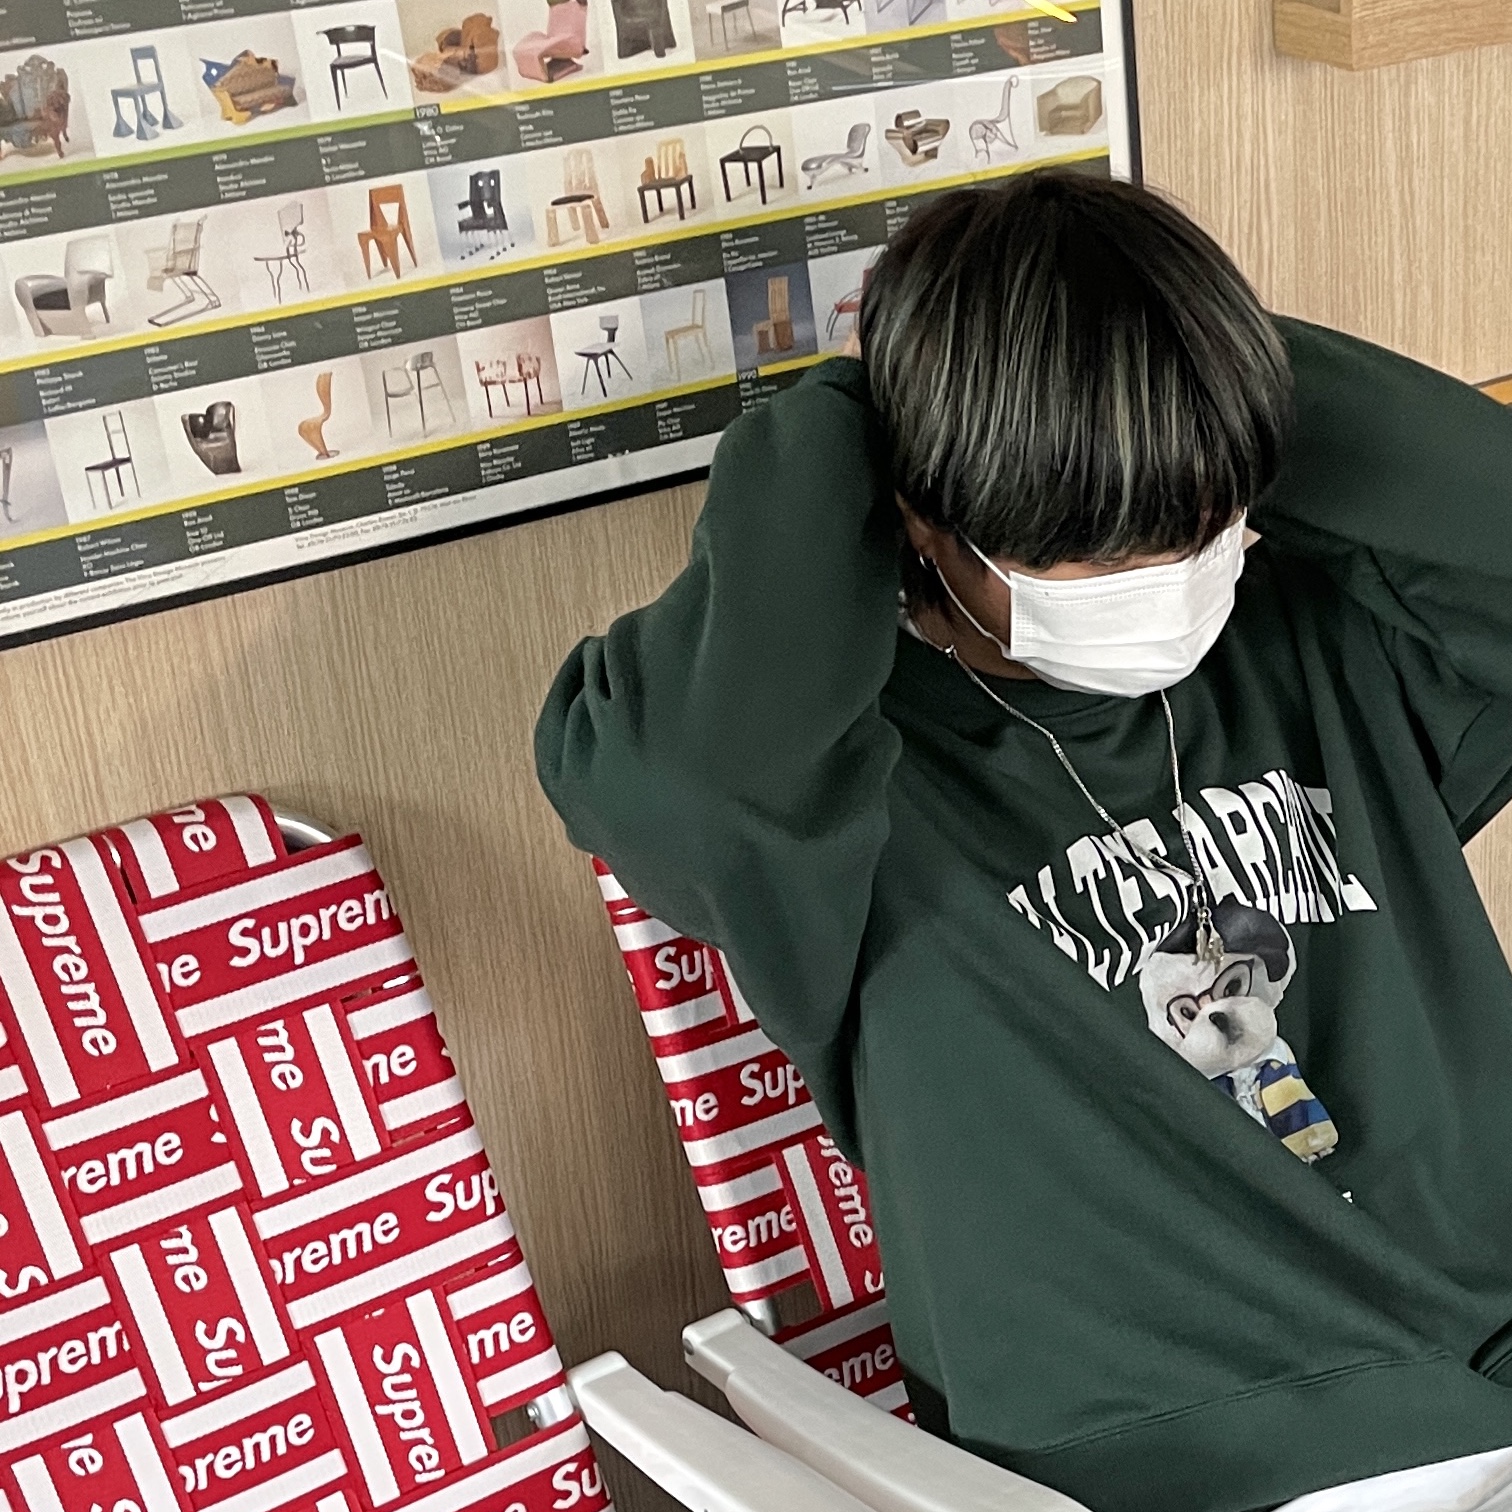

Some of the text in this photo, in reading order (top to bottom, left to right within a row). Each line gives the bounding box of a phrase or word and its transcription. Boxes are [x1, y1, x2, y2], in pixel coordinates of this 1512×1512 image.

[415, 104, 439, 119] 1980
[6, 848, 117, 1057] Supreme
[0, 1320, 131, 1414] prem
